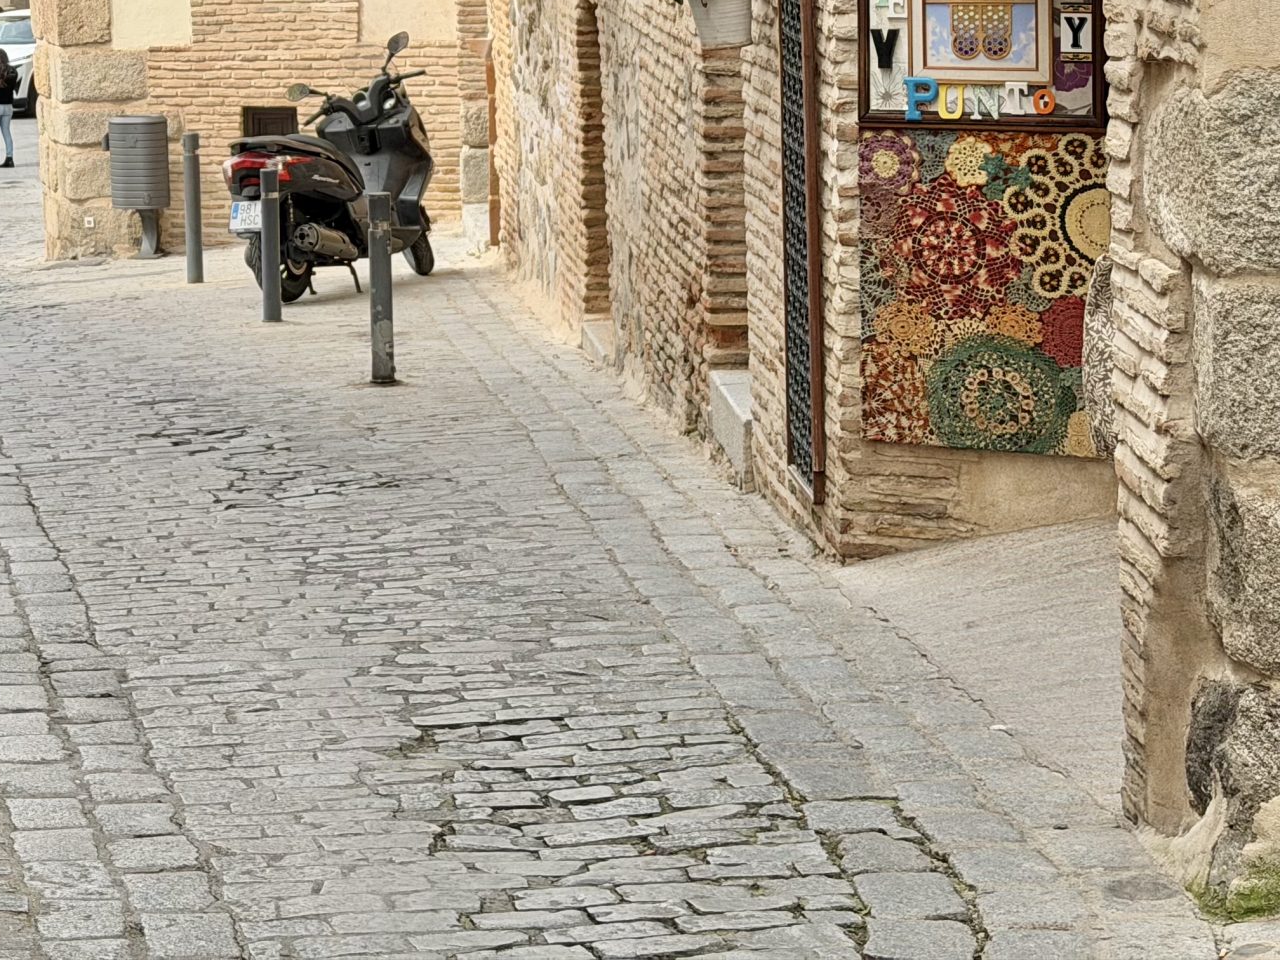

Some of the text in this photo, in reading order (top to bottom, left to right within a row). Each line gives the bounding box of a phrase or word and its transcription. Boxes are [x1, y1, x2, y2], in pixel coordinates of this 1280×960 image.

[870, 28, 900, 69] Y
[1065, 16, 1088, 49] Y
[903, 76, 1056, 121] PUNTO
[240, 214, 260, 227] HSC
